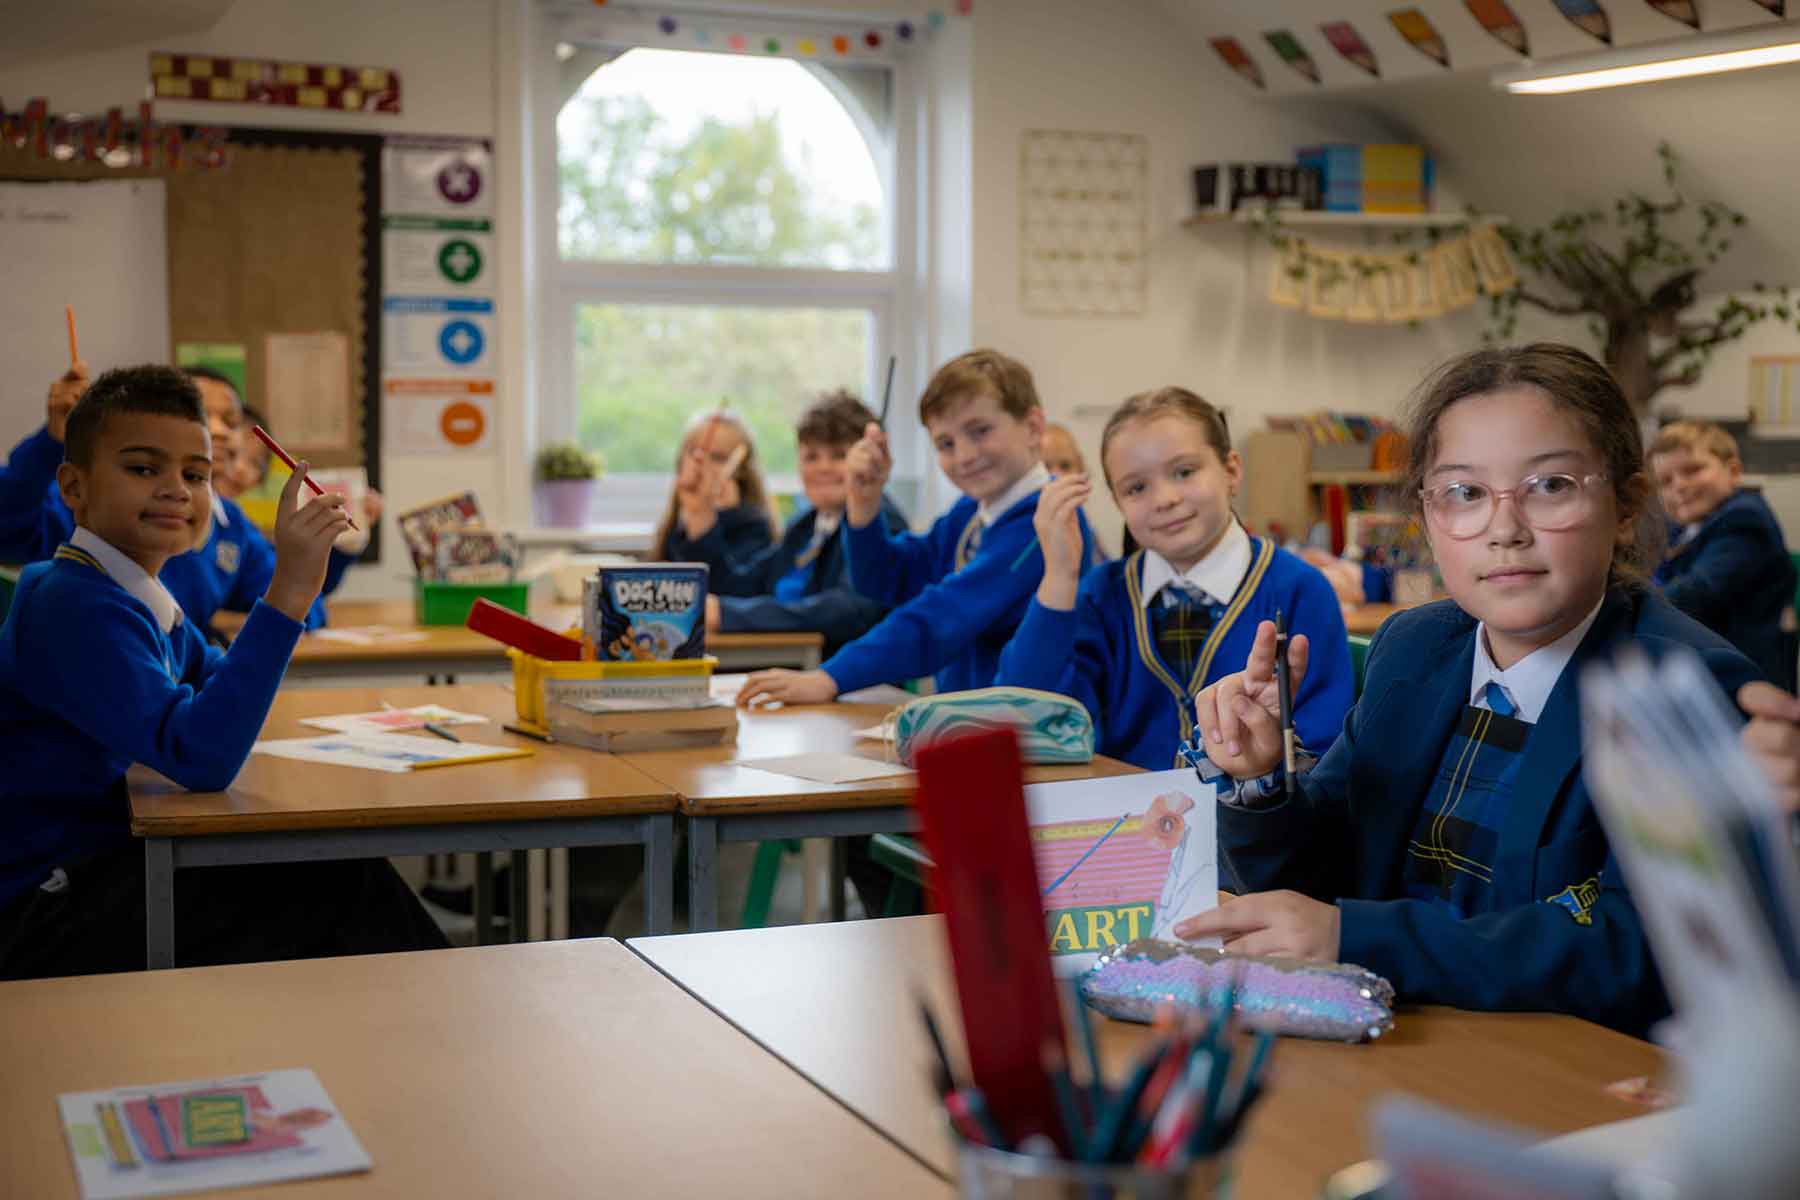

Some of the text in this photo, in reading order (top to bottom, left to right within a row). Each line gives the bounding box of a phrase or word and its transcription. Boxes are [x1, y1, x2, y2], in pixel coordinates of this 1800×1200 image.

[615, 579, 695, 604] DOG MAN
[1051, 906, 1149, 950] ART
